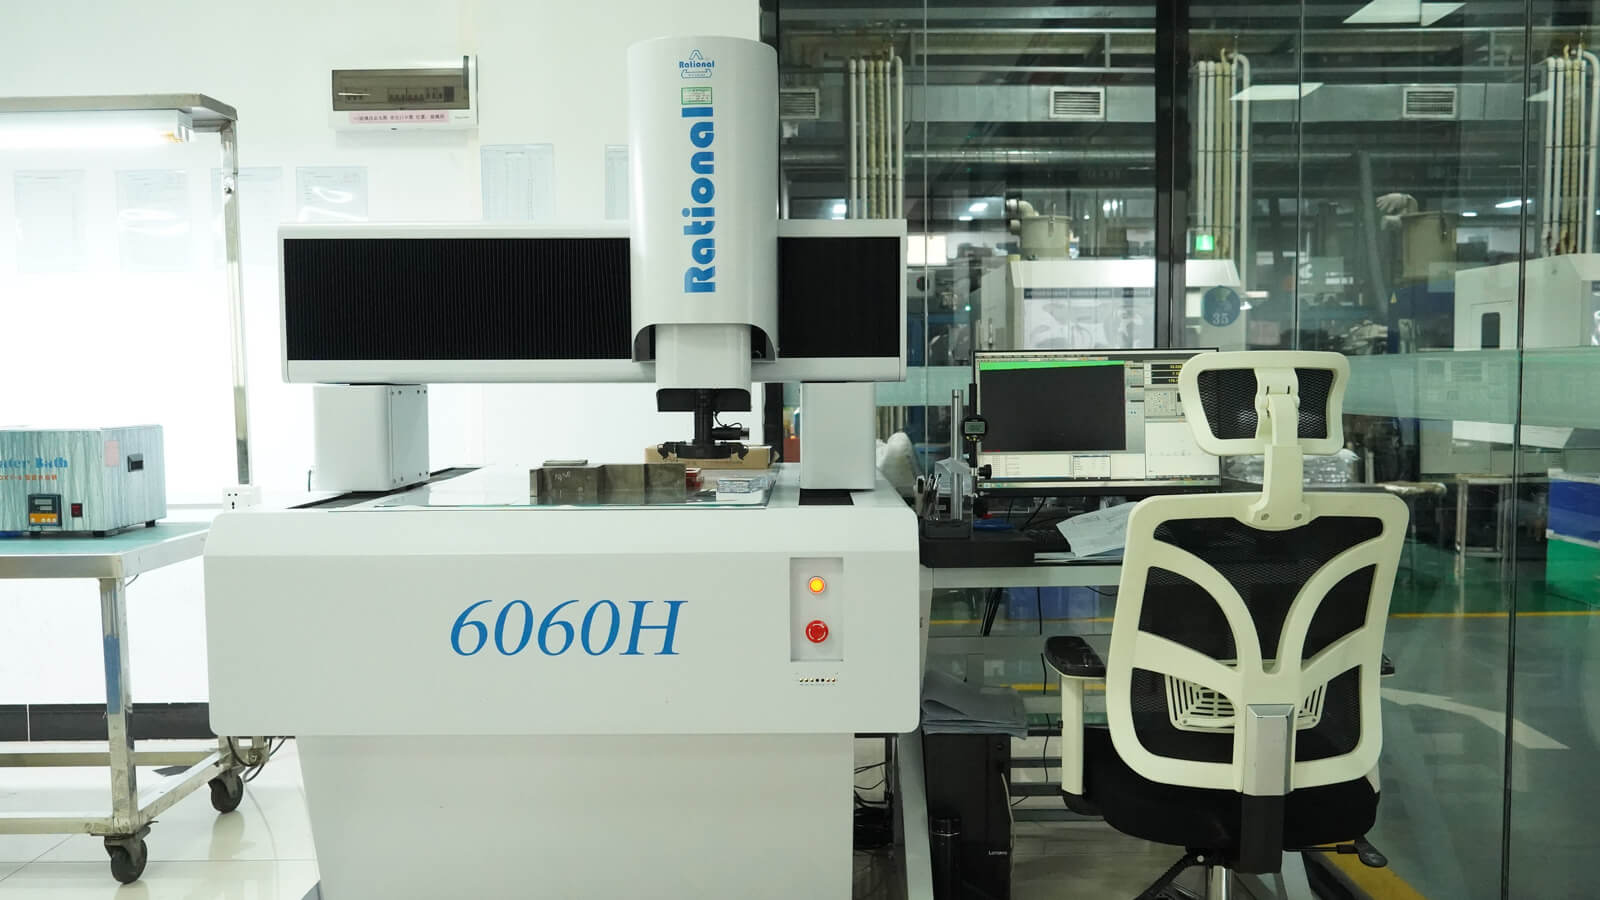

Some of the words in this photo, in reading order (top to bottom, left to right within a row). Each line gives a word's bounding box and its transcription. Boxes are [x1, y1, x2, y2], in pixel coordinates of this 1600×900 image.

[679, 60, 715, 69] Rational
[681, 106, 716, 293] Rational
[1212, 312, 1230, 325] 35
[35, 456, 68, 468] Bath
[450, 599, 688, 656] 6060H
